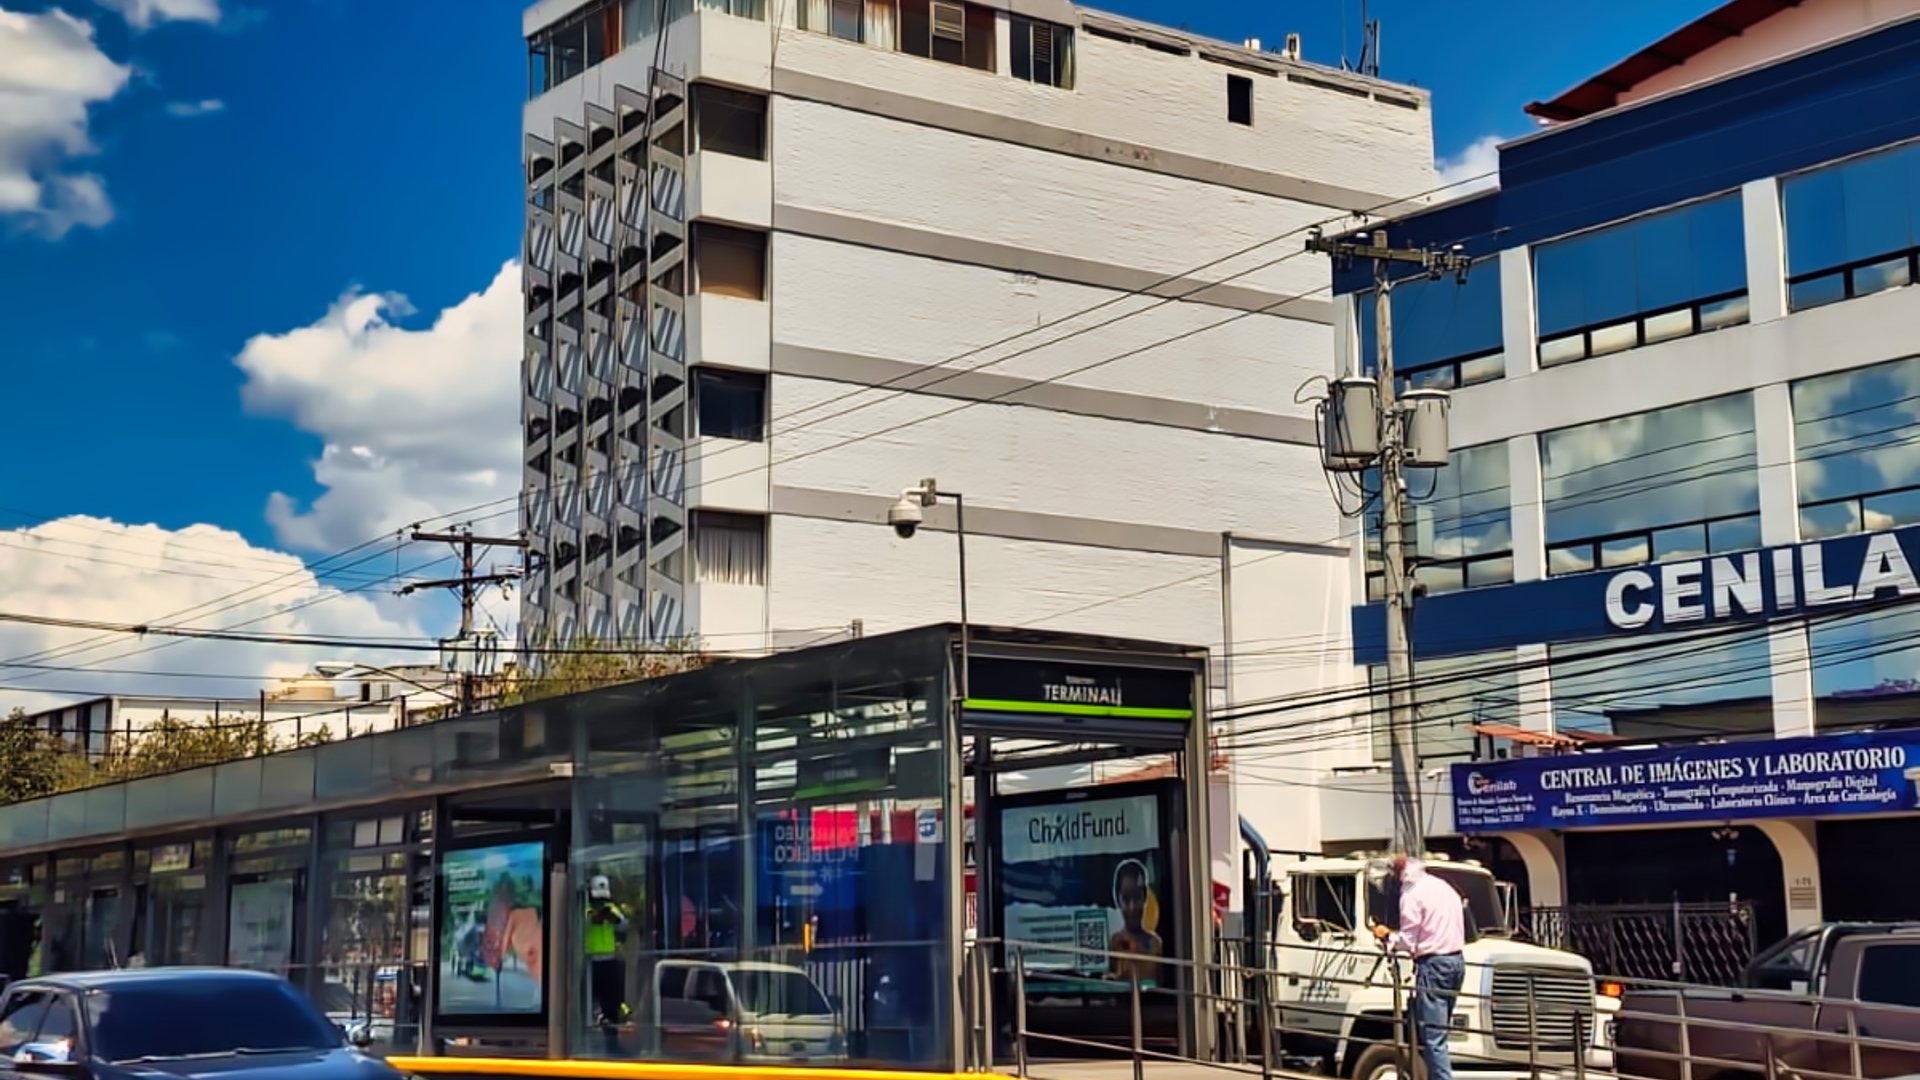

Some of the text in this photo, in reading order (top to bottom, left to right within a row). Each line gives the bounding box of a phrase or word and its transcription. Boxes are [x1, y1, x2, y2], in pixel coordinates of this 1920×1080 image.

[1605, 532, 1920, 629] CENILA
[1043, 683, 1119, 704] TERMINAL
[1540, 746, 1906, 790] CENTRAL DE IMÁGENES Y LABORATORIO
[1845, 773, 1878, 790] Digital
[1827, 790, 1840, 803] de
